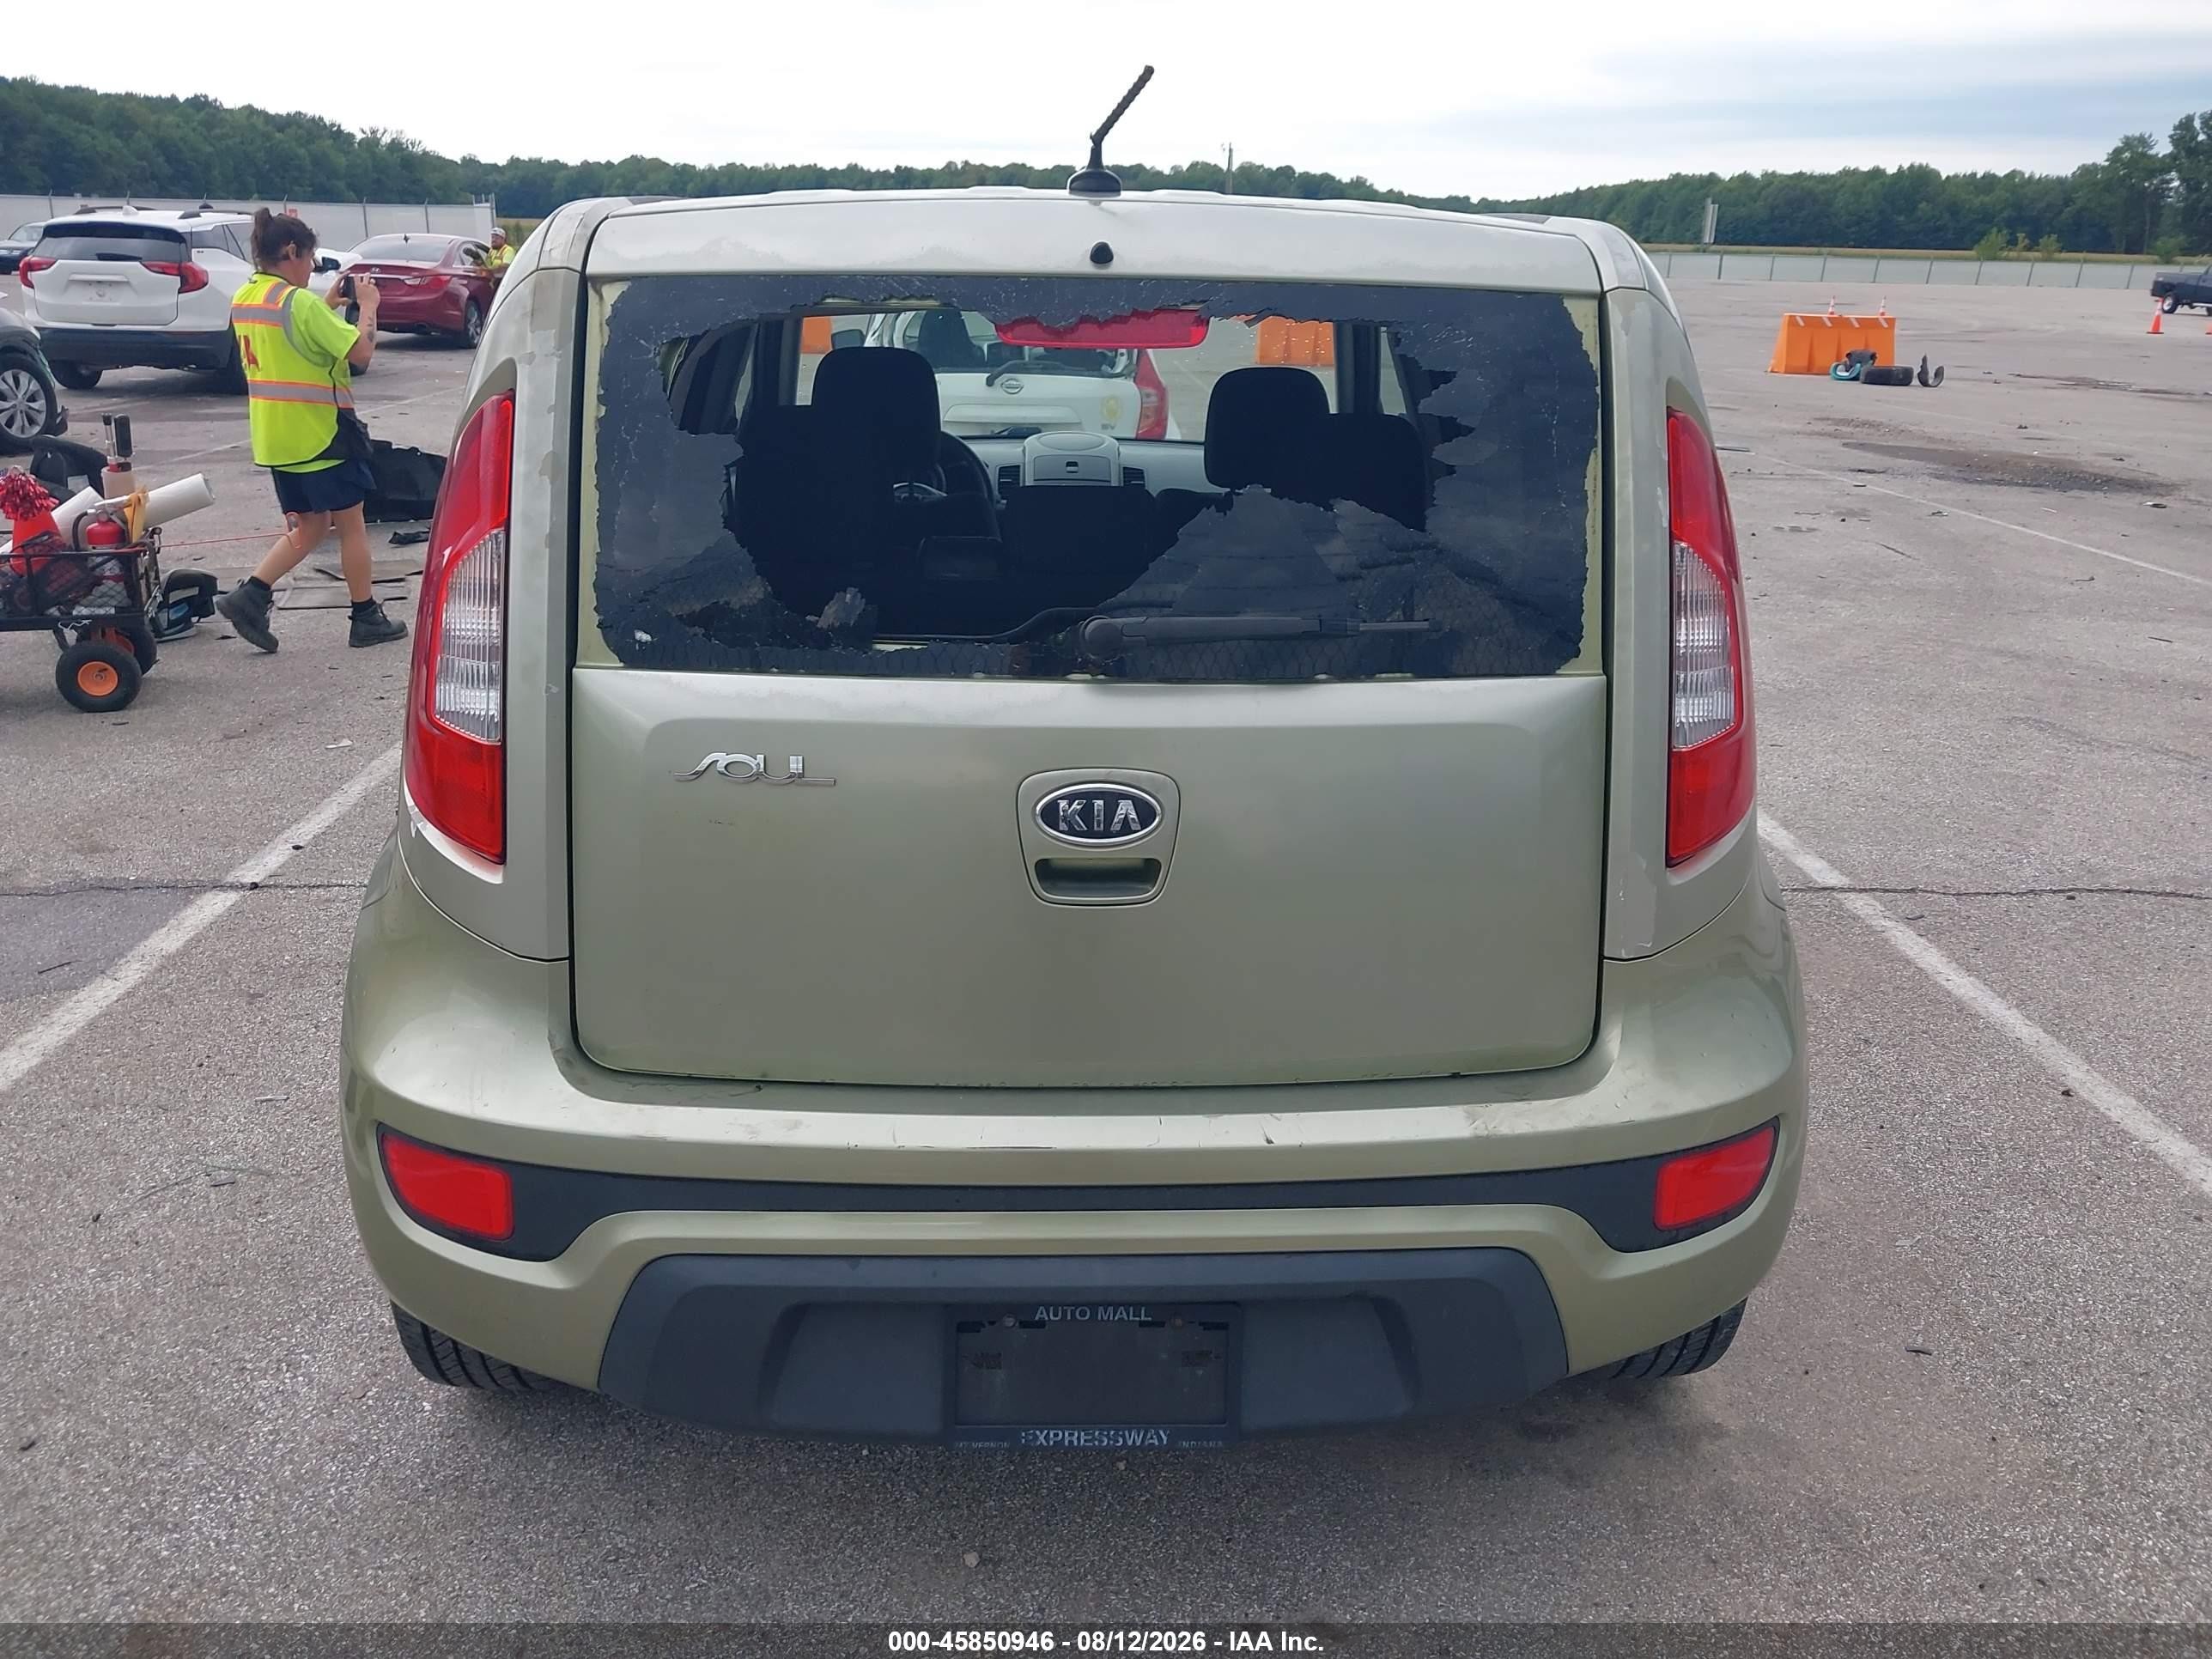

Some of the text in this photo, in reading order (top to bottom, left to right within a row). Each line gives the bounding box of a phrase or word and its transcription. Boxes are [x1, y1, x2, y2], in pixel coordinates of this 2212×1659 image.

[1057, 799, 1142, 831] KIA
[1034, 1305, 1152, 1321] AUTO MALL
[1021, 1428, 1170, 1447] EXPRESSWAY
